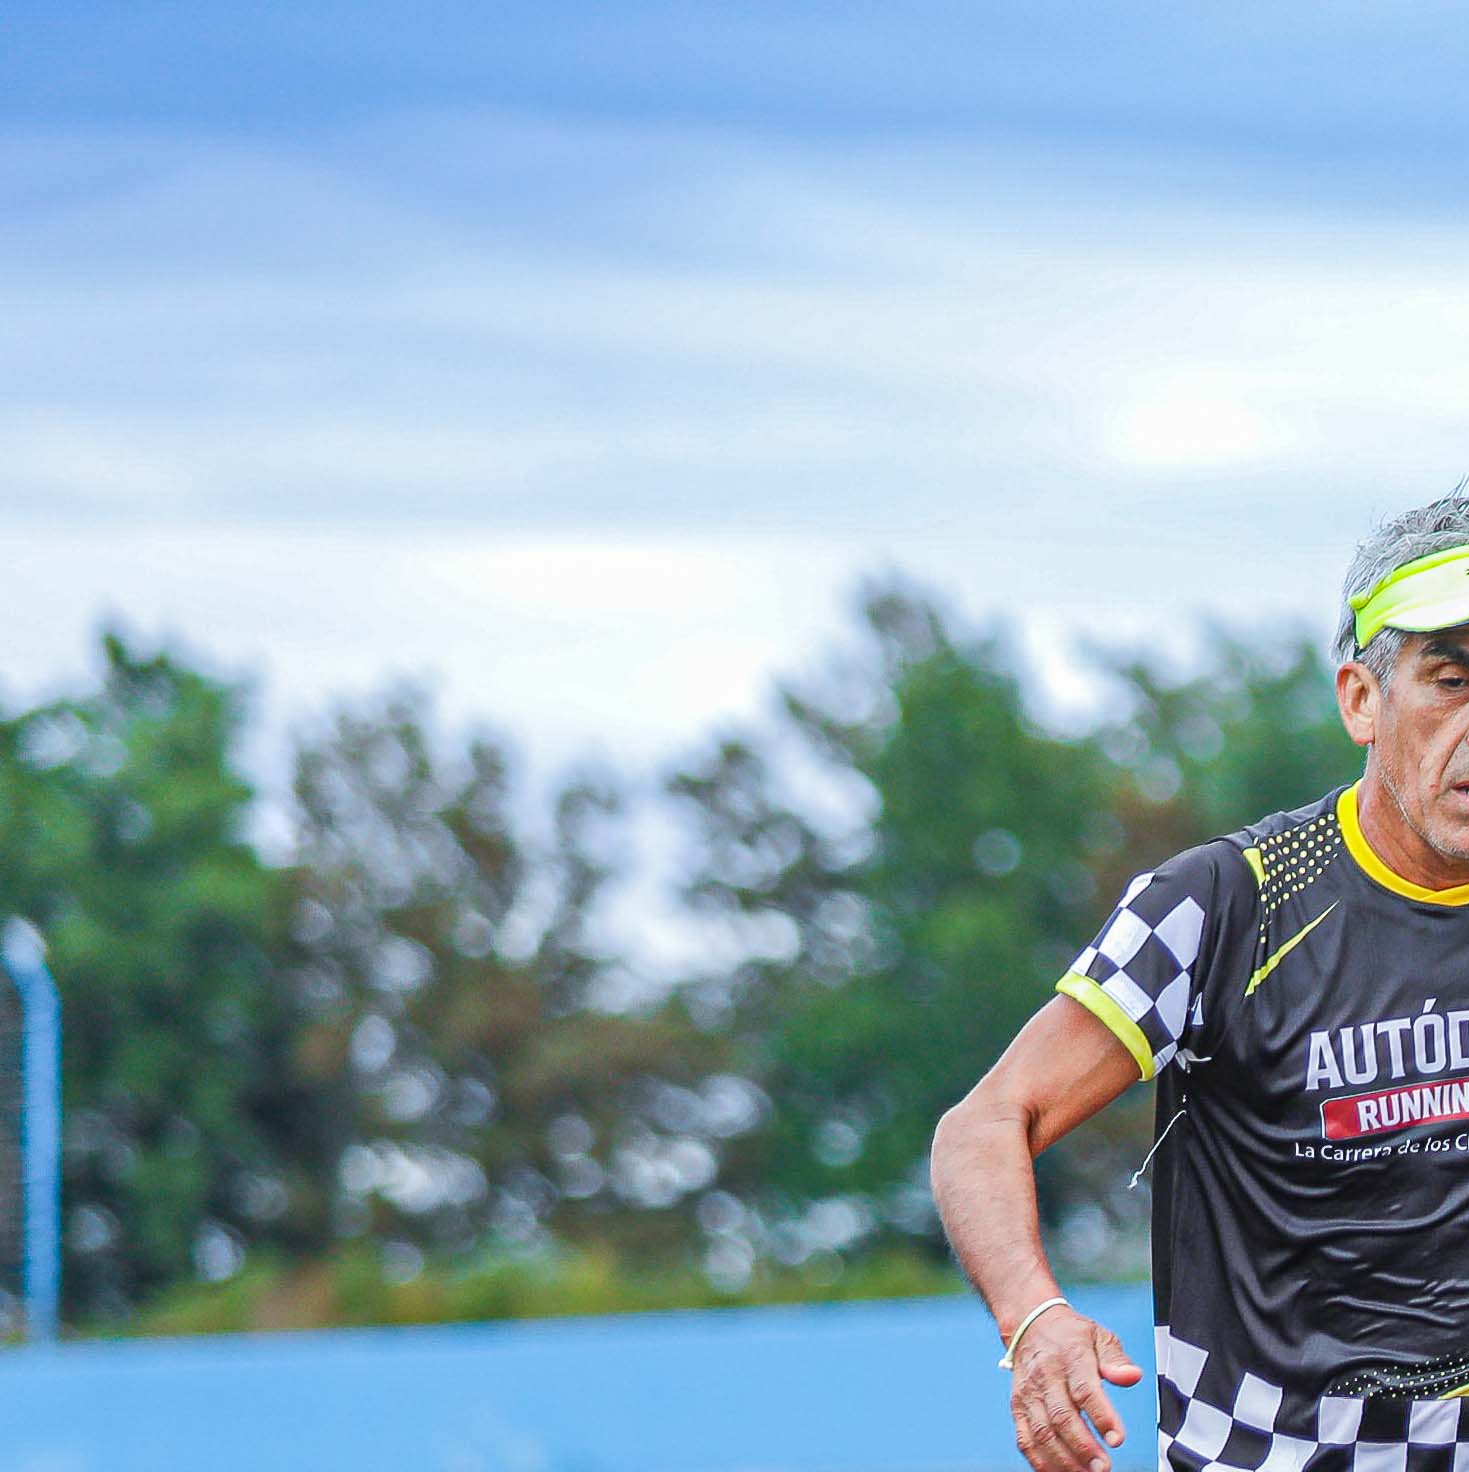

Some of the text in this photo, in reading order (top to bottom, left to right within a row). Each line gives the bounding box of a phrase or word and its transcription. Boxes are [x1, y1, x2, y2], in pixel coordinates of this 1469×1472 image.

[1295, 1142, 1315, 1159] La
[1320, 1145, 1392, 1162] Carrera
[1398, 1139, 1420, 1155] de
[1424, 1137, 1450, 1153] los
